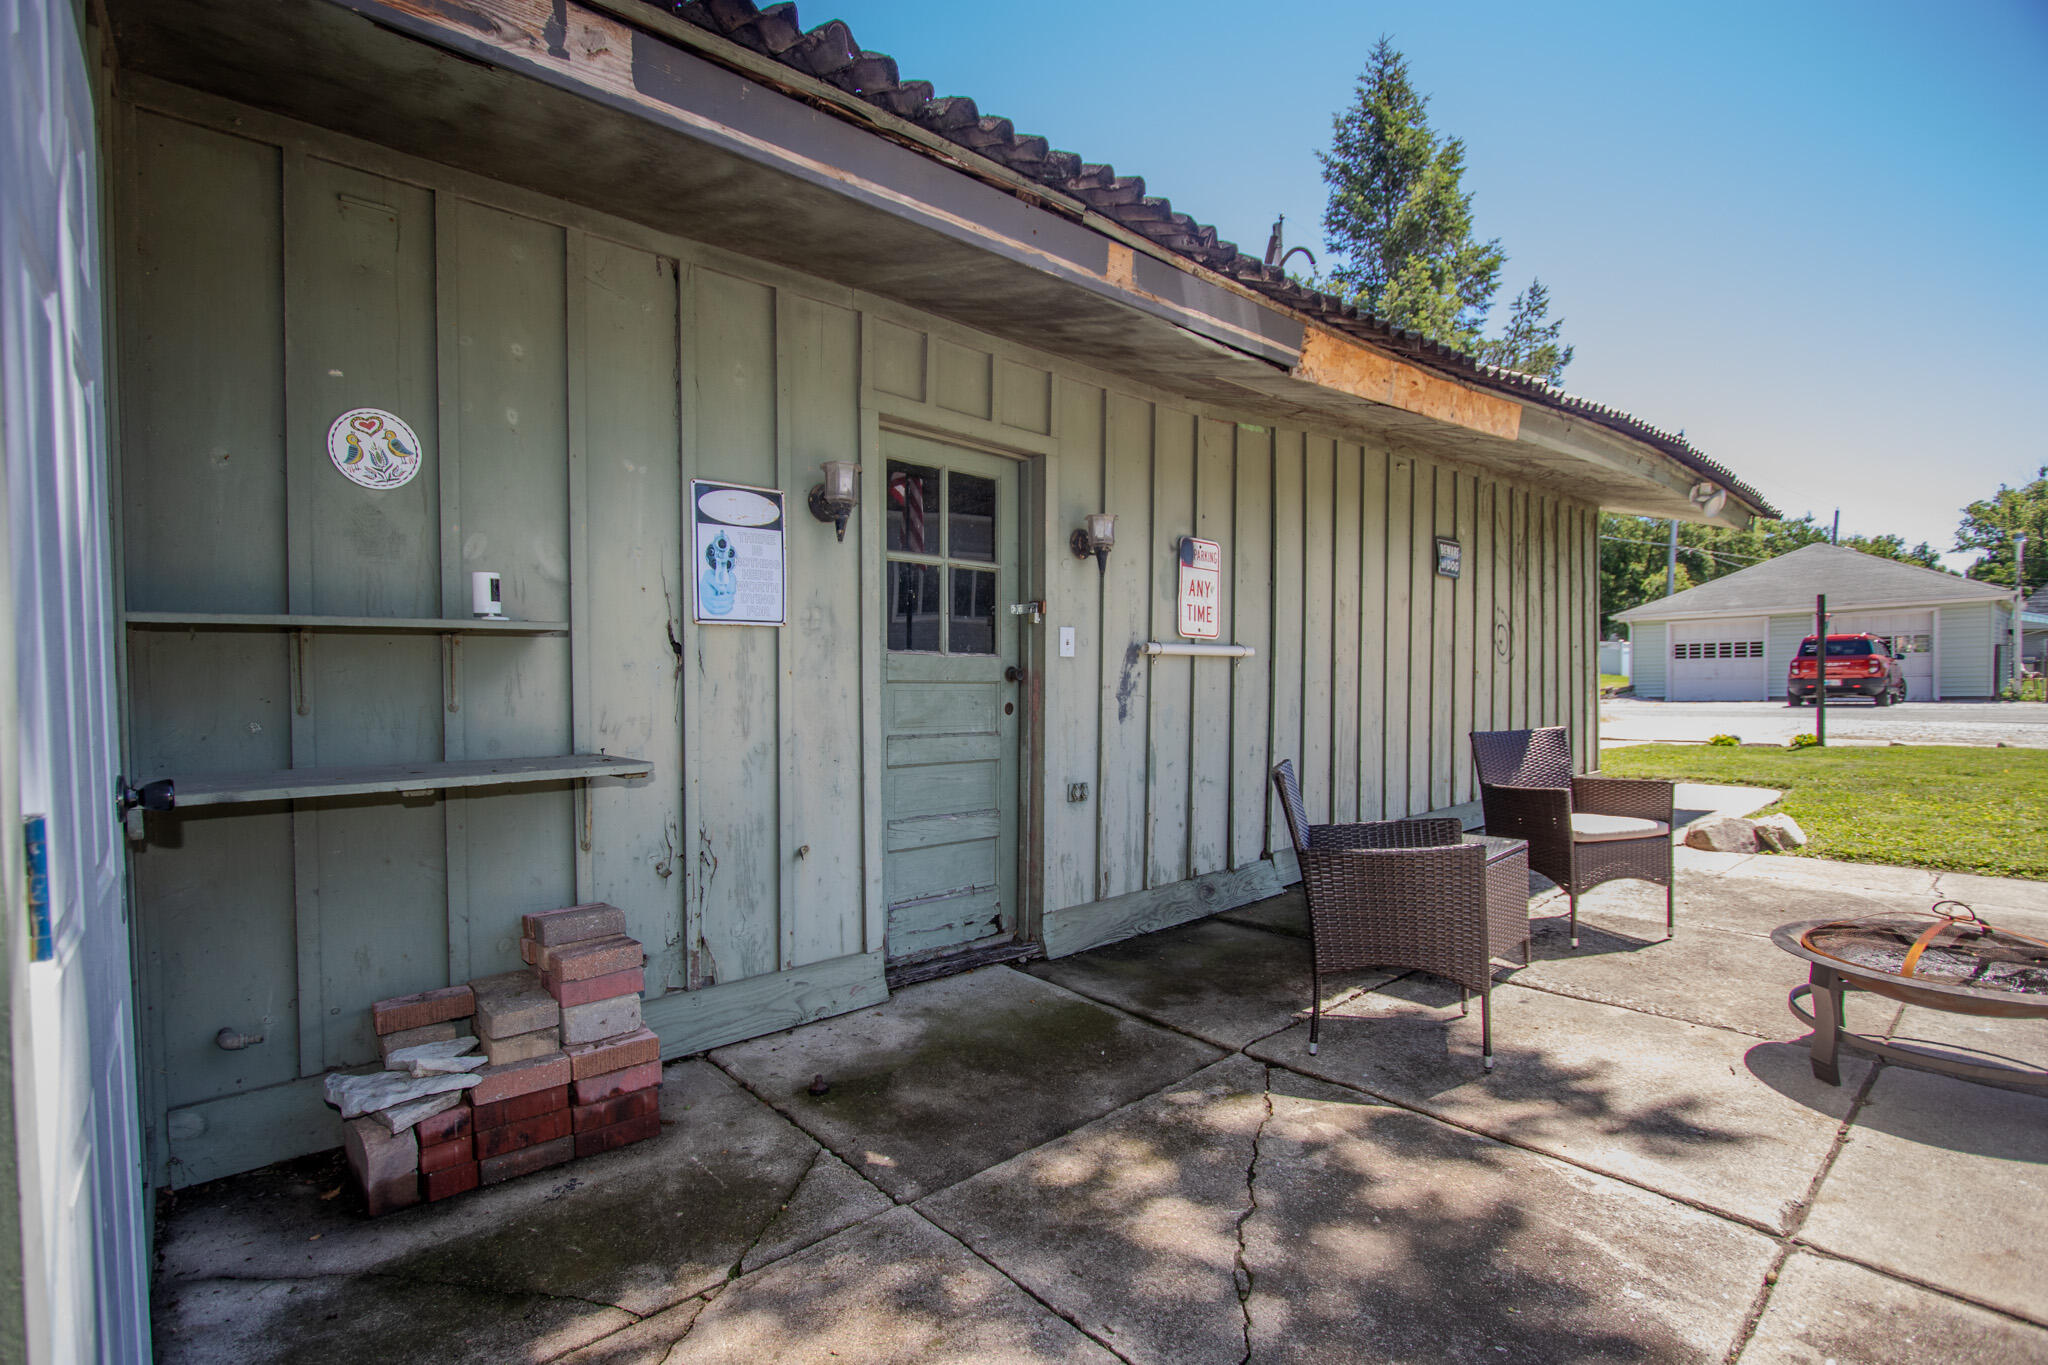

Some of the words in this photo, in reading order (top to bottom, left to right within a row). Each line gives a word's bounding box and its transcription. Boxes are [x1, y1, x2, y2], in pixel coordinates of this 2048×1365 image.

[1193, 548, 1218, 565] PARKING
[1188, 578, 1211, 599] ANY
[1187, 603, 1213, 623] TIME
